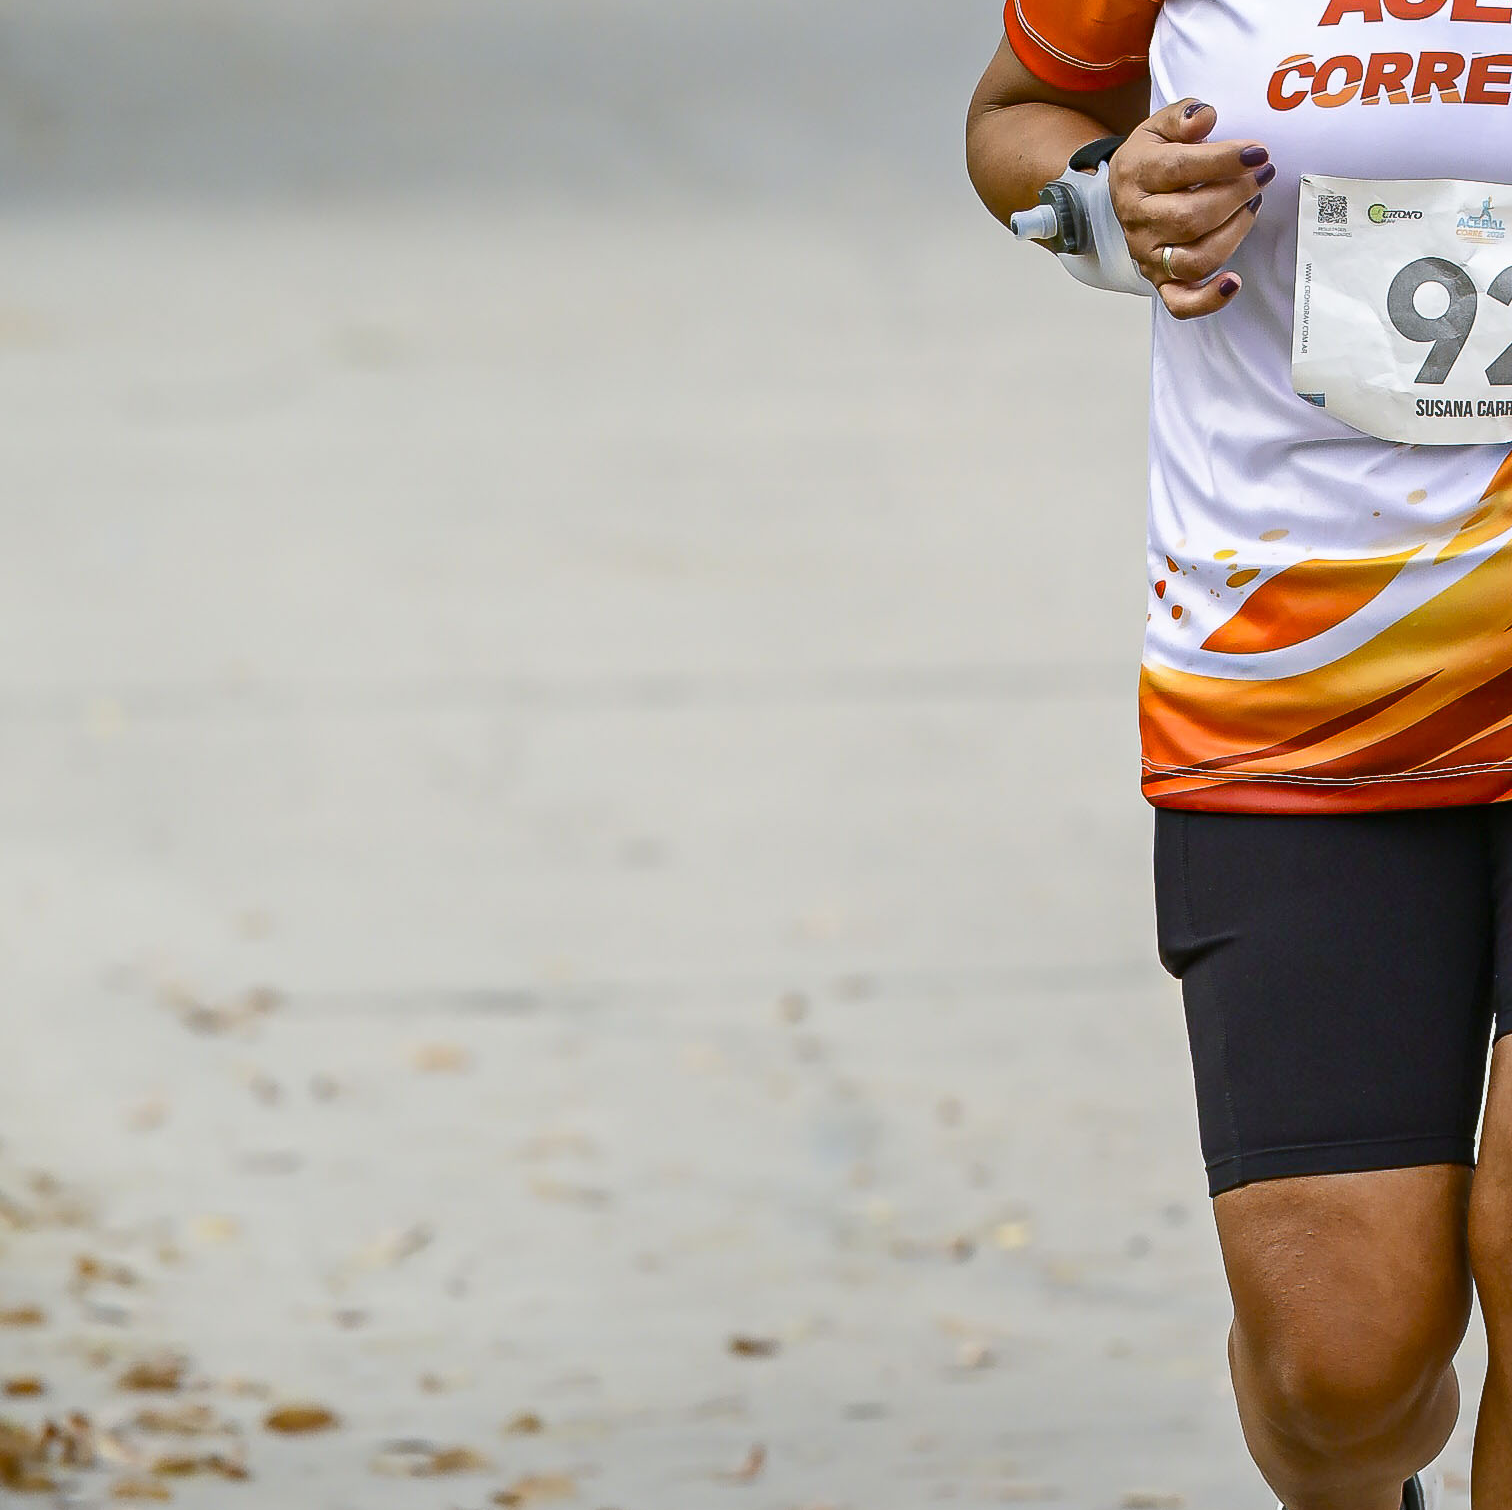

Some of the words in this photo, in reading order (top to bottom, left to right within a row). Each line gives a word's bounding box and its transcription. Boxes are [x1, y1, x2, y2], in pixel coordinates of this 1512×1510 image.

[1457, 216, 1506, 230] ACEBAL
[1456, 229, 1484, 238] CORRE
[1415, 398, 1473, 418] SUSANA
